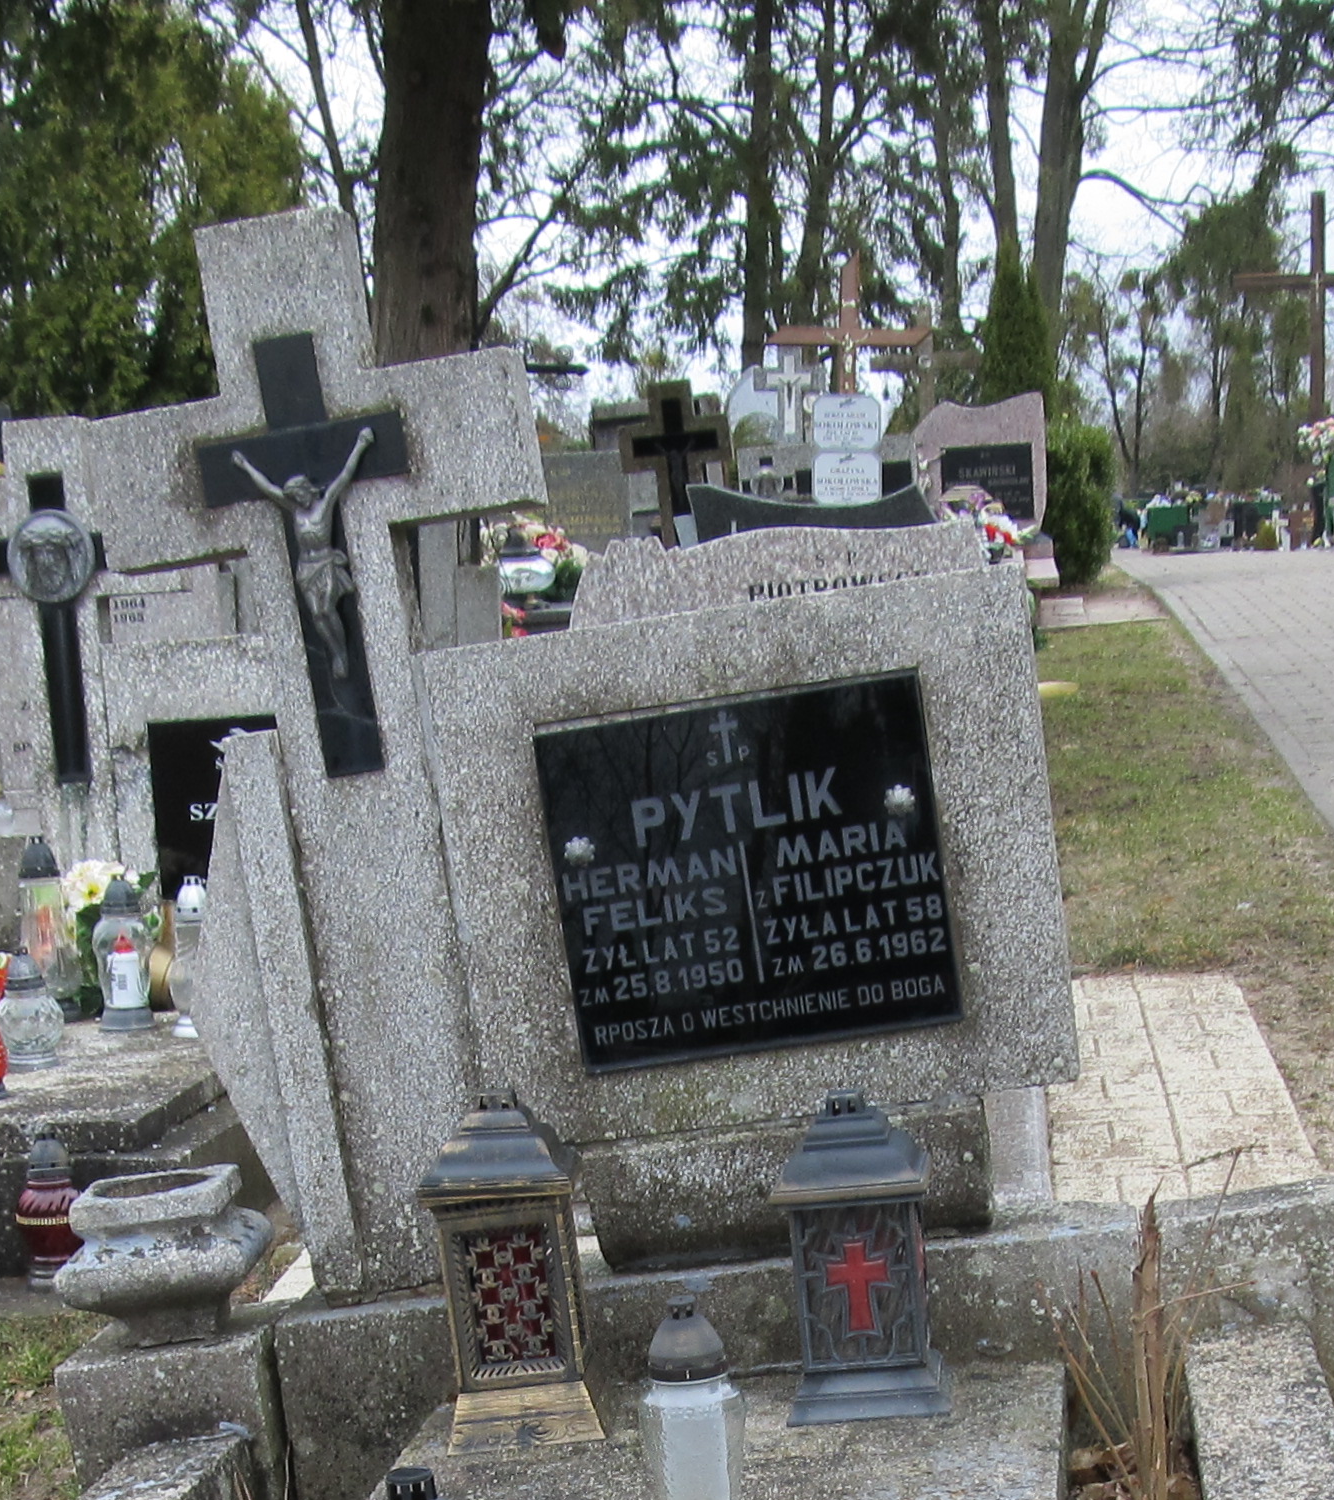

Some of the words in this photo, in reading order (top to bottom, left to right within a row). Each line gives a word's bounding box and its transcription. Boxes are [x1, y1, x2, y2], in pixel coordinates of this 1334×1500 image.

[630, 767, 842, 848] PYTLIK
[777, 819, 907, 868] MARIA
[562, 846, 738, 901] HERMAN
[773, 852, 939, 906] FILIPCZUK
[583, 887, 728, 936] FELIKS
[844, 901, 898, 933] LAT
[907, 894, 943, 923] 58
[642, 932, 695, 964] LAT
[704, 926, 740, 954] 52
[812, 927, 947, 970] 26.6.1962
[613, 958, 744, 1000] 25.8.1950
[701, 988, 851, 1029] WESTCHNIENIE
[857, 984, 884, 1006] DO
[891, 975, 946, 1001] BOGA
